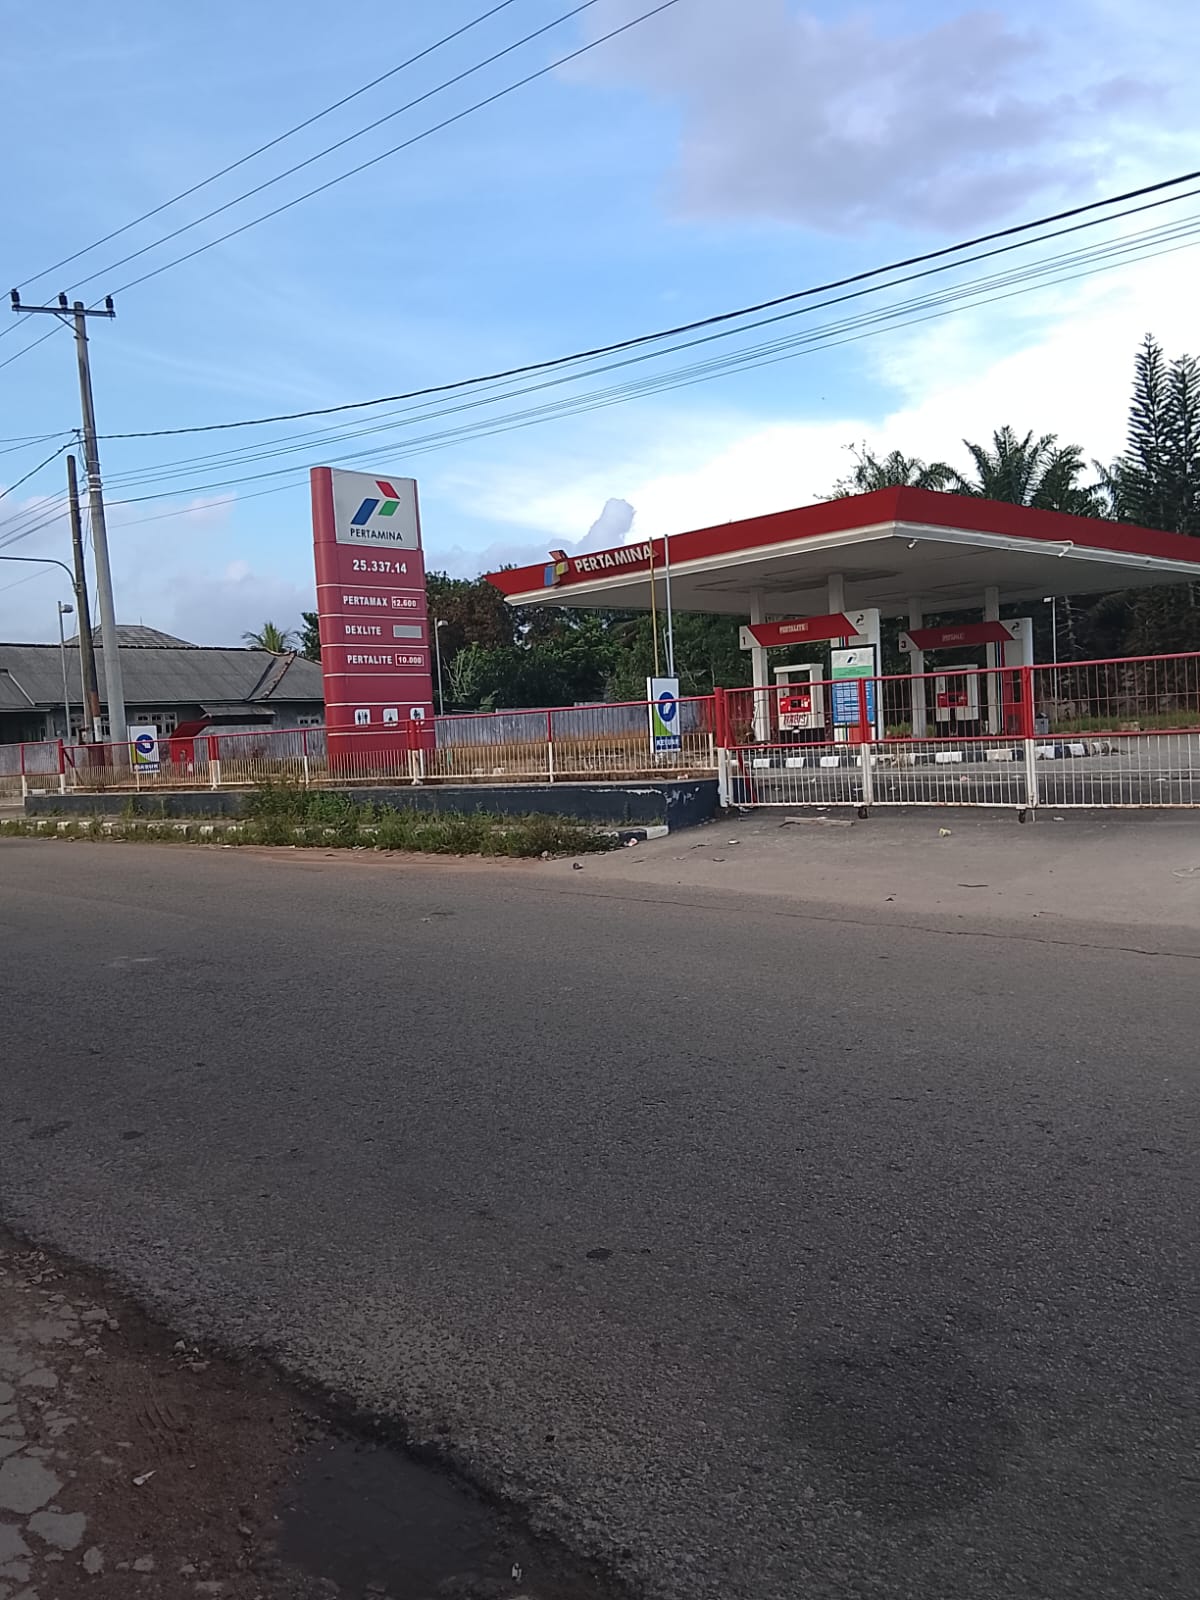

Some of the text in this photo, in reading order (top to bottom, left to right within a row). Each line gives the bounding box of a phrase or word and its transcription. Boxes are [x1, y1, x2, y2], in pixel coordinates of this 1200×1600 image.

[350, 527, 403, 541] PERTAMINA
[574, 544, 655, 573] PERTAMINA
[352, 559, 407, 574] 25.337.14
[343, 595, 388, 606] PERTAMAX
[345, 625, 381, 635] DEXLITE
[347, 655, 422, 665] PERTALITE 10.000
